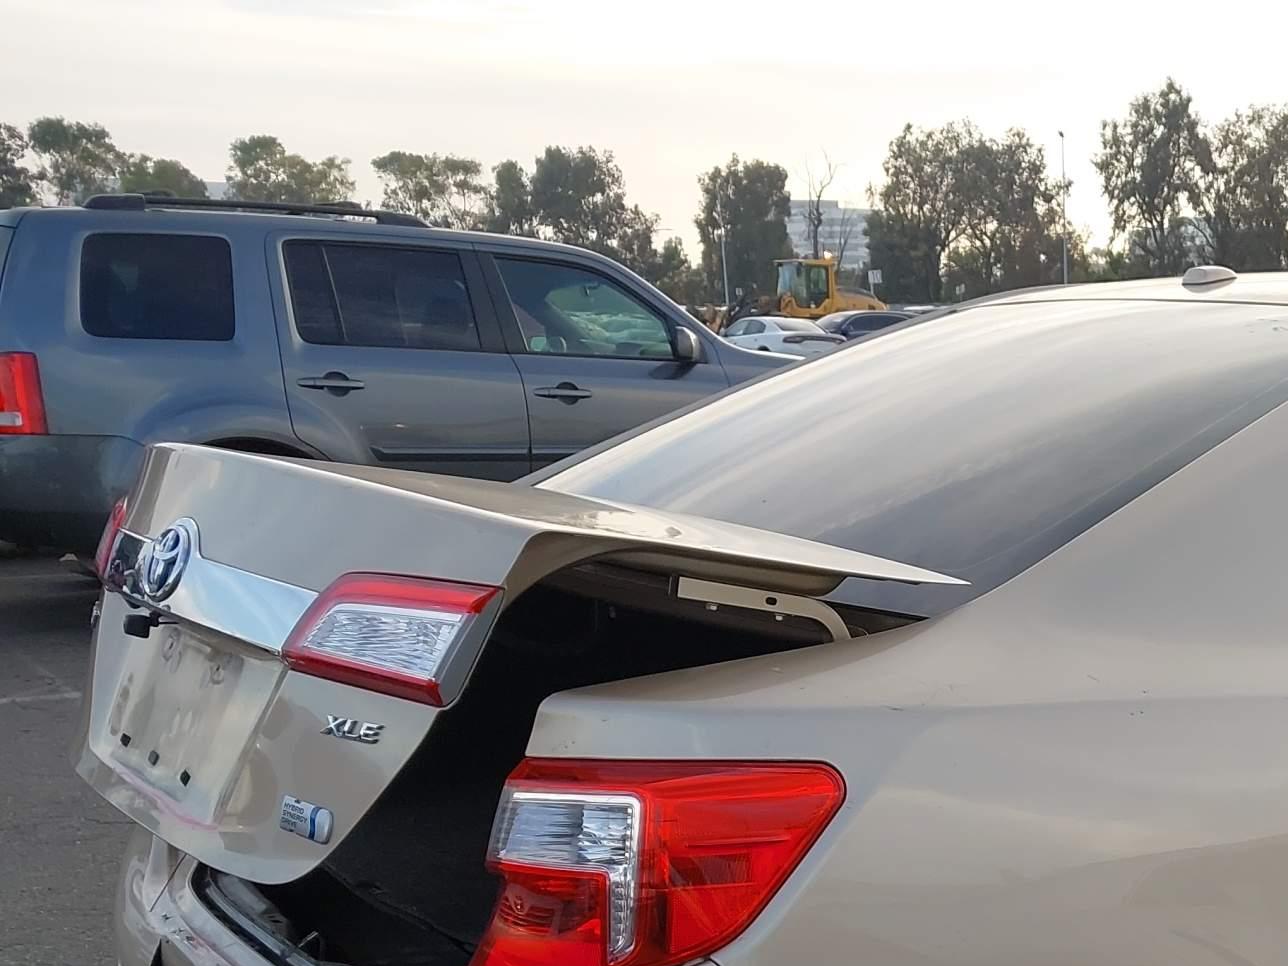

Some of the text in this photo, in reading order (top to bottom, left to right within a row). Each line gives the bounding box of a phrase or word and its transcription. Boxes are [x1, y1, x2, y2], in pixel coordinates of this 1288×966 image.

[320, 714, 384, 744] XLE
[284, 801, 305, 815] HYBRID
[282, 809, 308, 823] SYNERGY
